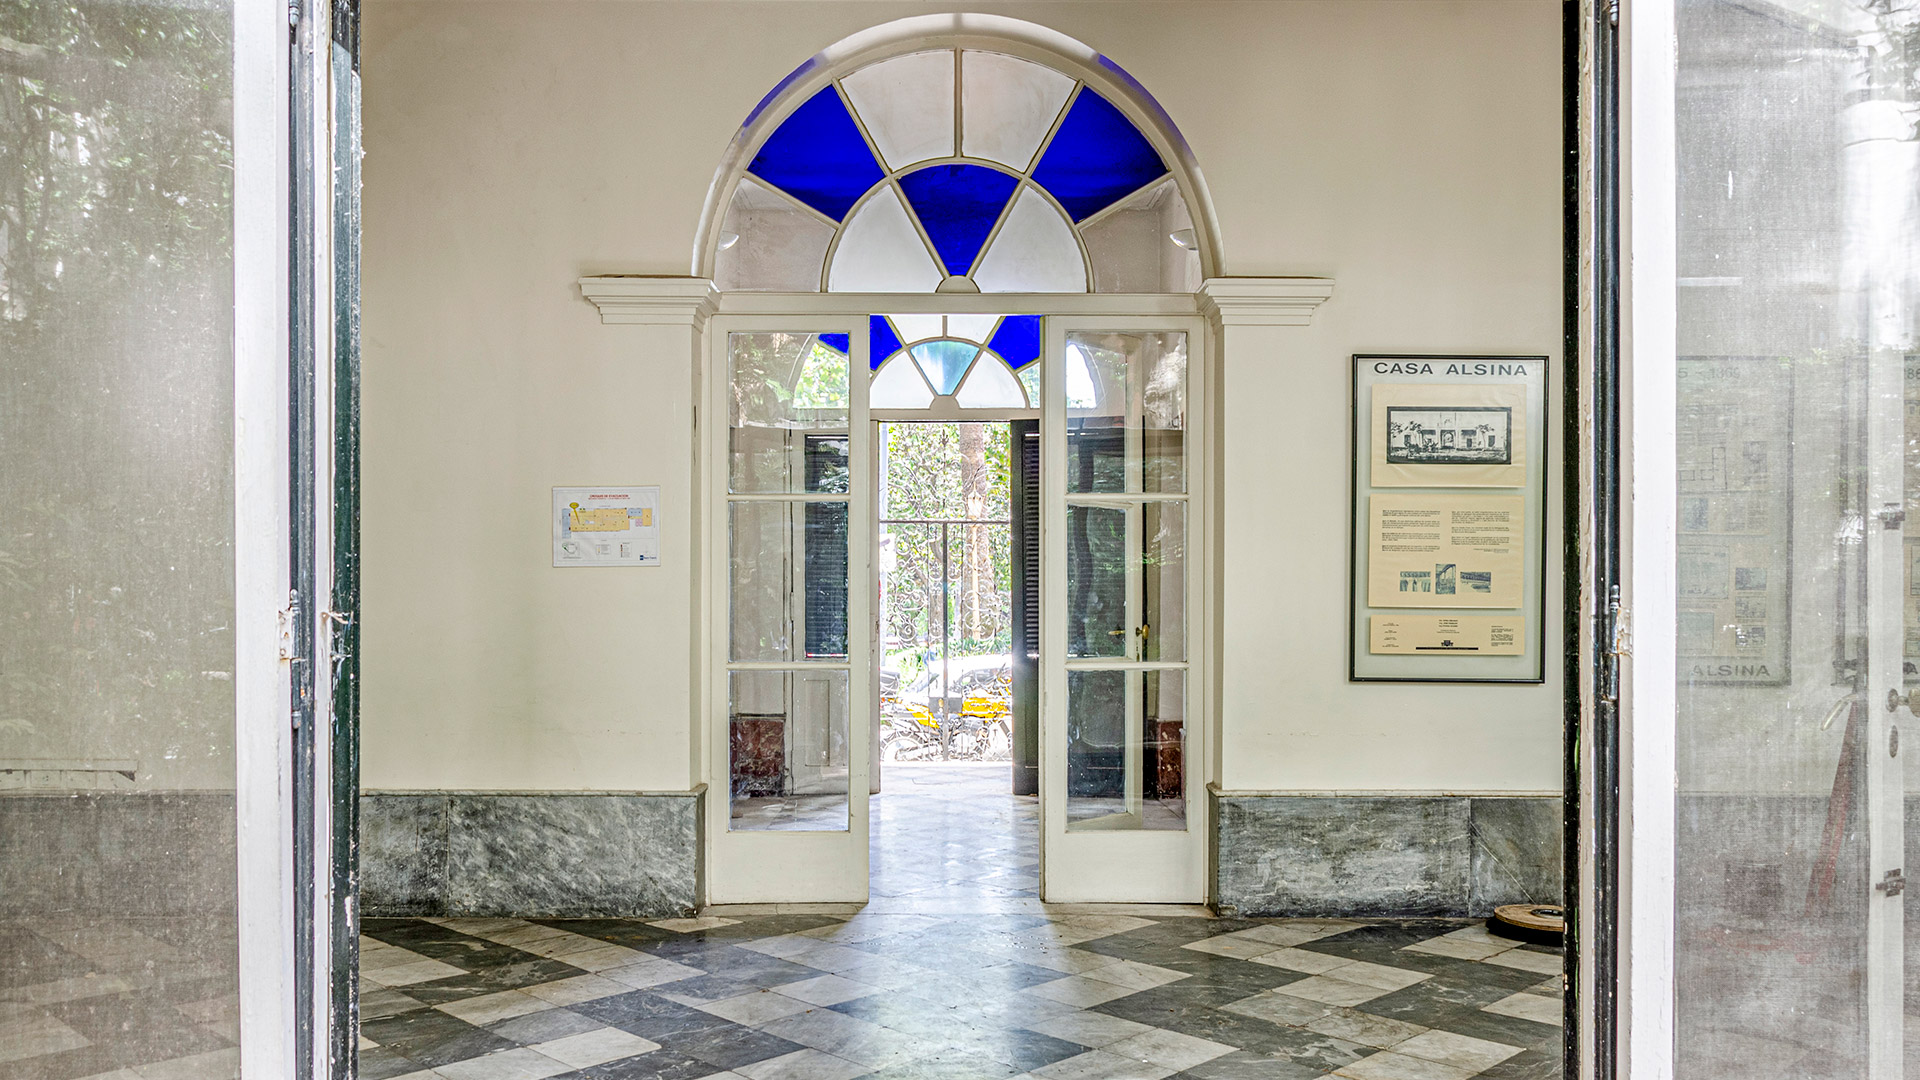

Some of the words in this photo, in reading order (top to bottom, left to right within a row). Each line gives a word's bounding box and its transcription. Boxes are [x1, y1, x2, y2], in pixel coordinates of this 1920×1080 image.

[1374, 362, 1433, 375] CASA
[1446, 363, 1528, 376] ALSINA
[1691, 664, 1770, 677] ALSINA
